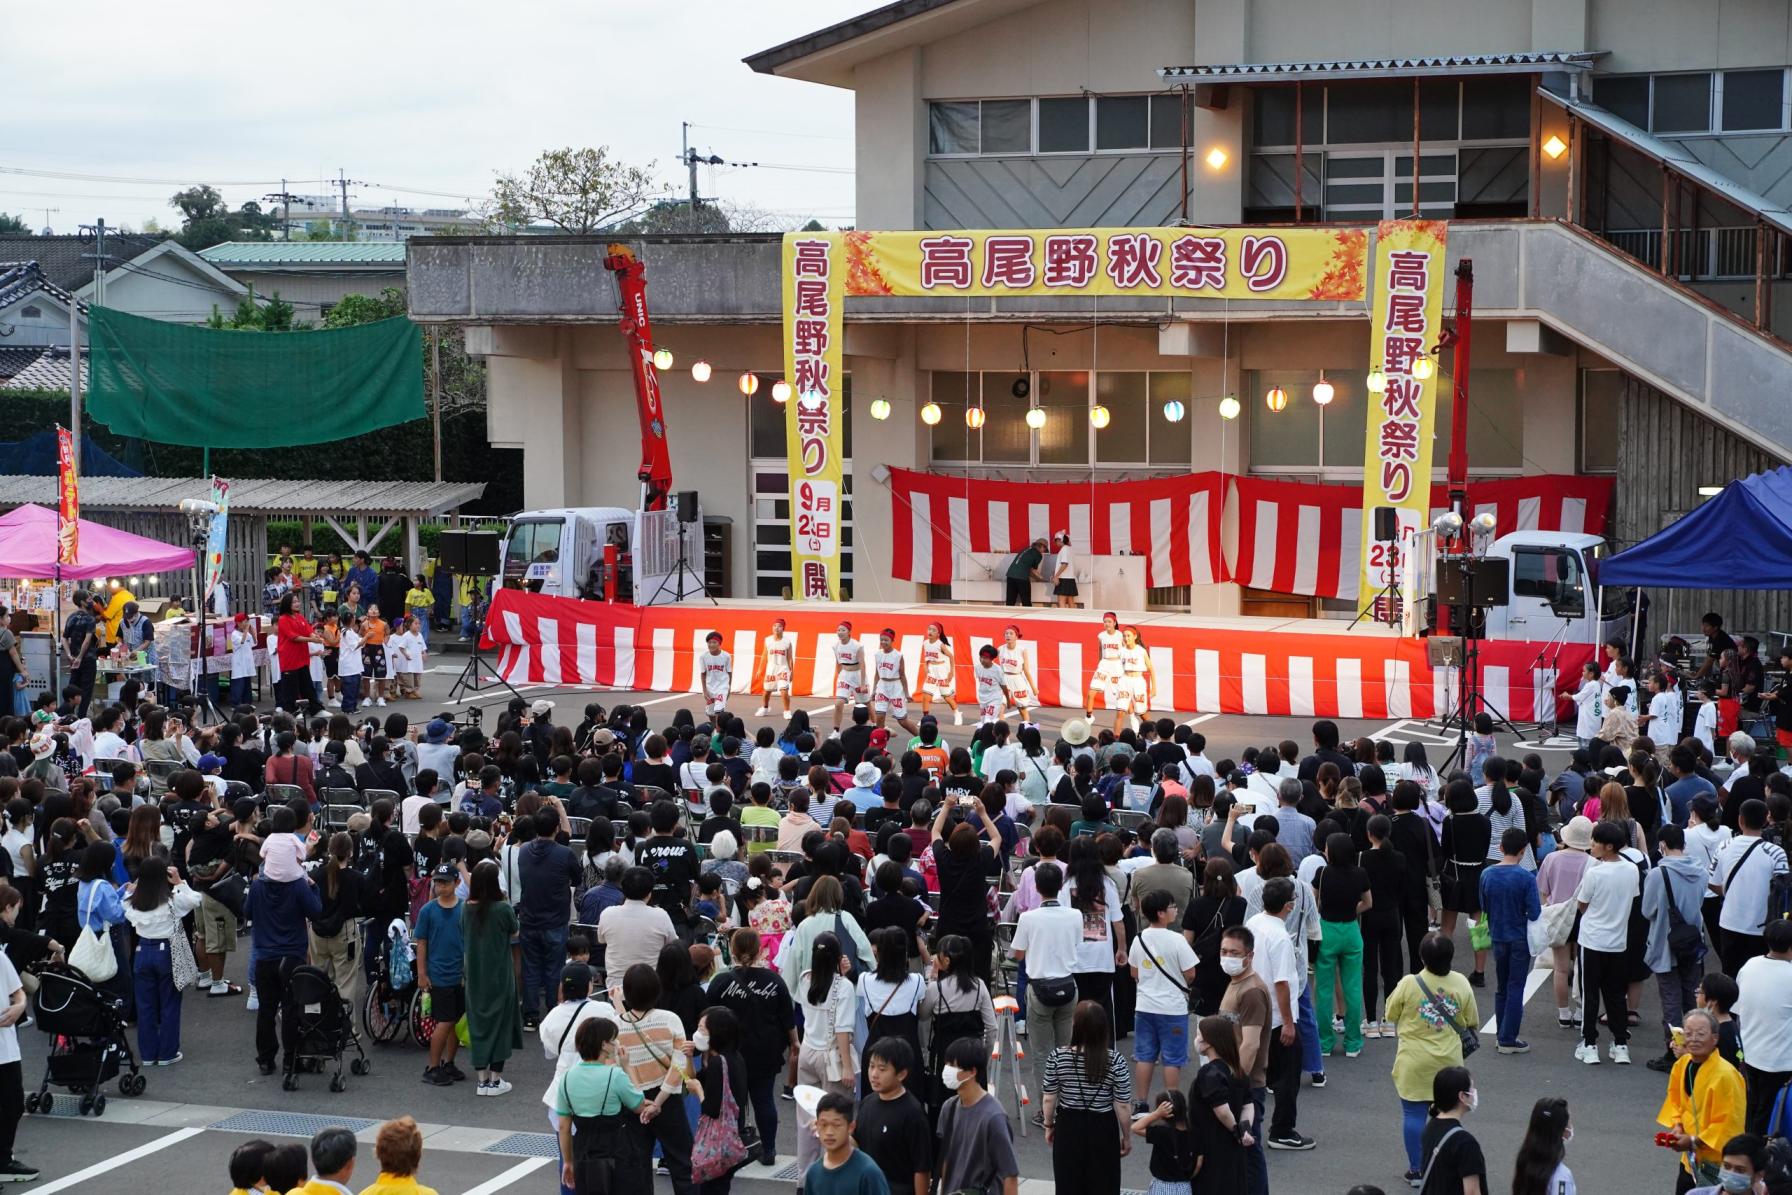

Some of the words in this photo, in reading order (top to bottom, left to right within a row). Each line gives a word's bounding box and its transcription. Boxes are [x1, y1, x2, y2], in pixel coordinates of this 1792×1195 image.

[635, 292, 645, 327] UNIC
[921, 237, 1287, 291] 高尾野秋祭り
[795, 240, 830, 475] 高尾野秋祭り
[1382, 252, 1429, 500] 高尾野秋祭り
